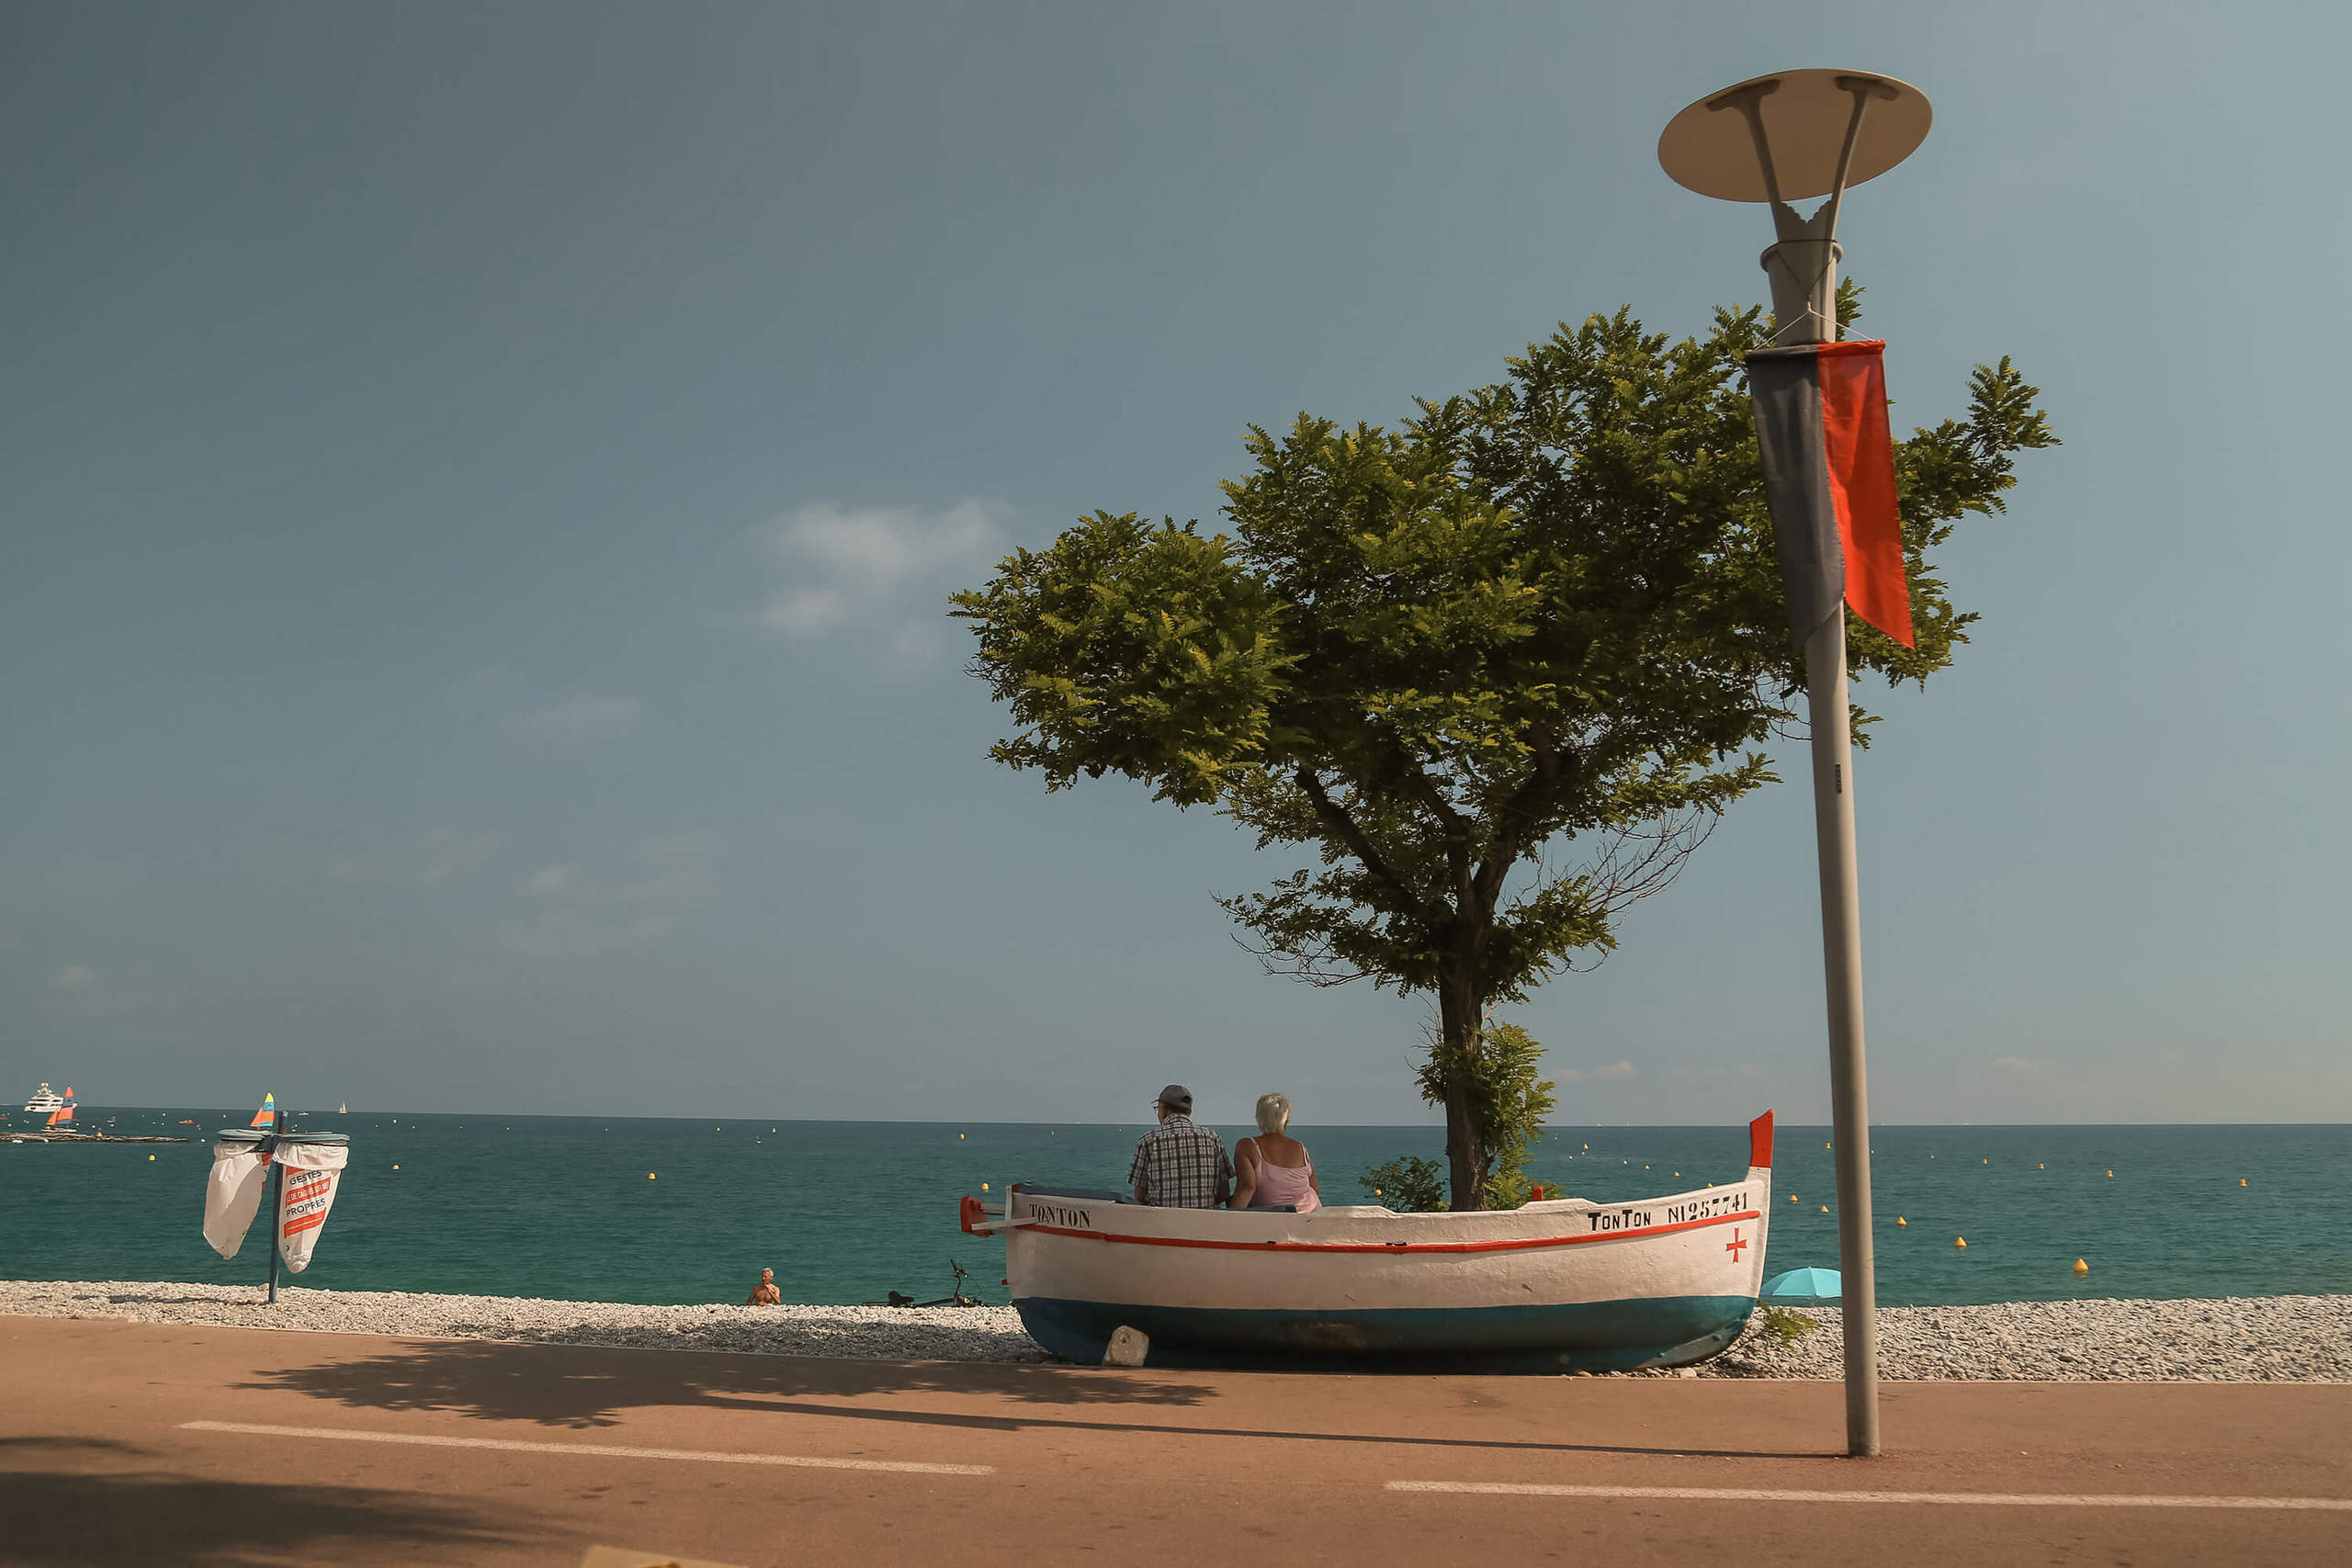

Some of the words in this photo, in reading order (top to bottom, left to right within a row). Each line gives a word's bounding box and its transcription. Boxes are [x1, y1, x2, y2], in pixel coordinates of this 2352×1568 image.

[289, 1169, 322, 1185] GESTES
[286, 1198, 326, 1217] PROPRES
[1029, 1203, 1091, 1228] TONTON
